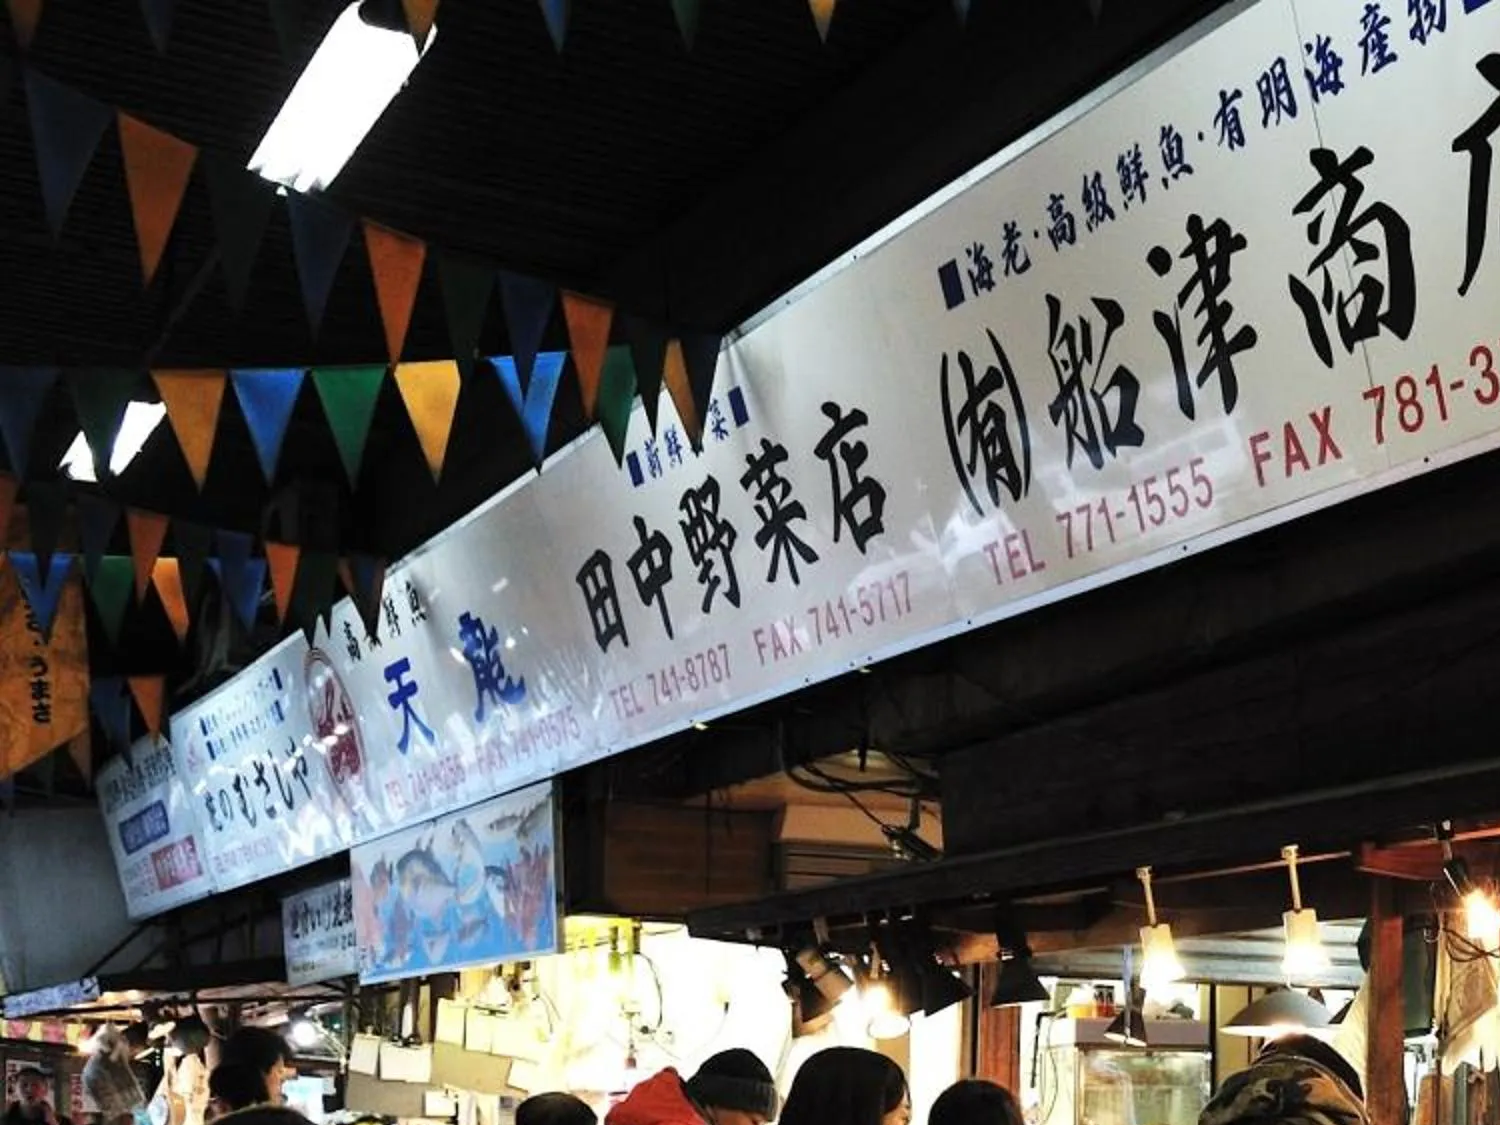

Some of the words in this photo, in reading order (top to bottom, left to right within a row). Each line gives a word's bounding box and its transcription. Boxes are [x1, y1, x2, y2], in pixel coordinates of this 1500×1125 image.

[643, 398, 729, 479] 新鮮菜
[983, 528, 1046, 587] TEL
[1056, 457, 1215, 560] 771-1555
[1249, 406, 1343, 488] FAX
[576, 401, 887, 655] 田中野菜店
[608, 683, 645, 722] TEL
[647, 644, 733, 710] 741-8787
[752, 620, 803, 667] FAX
[807, 571, 914, 648] 741-5717
